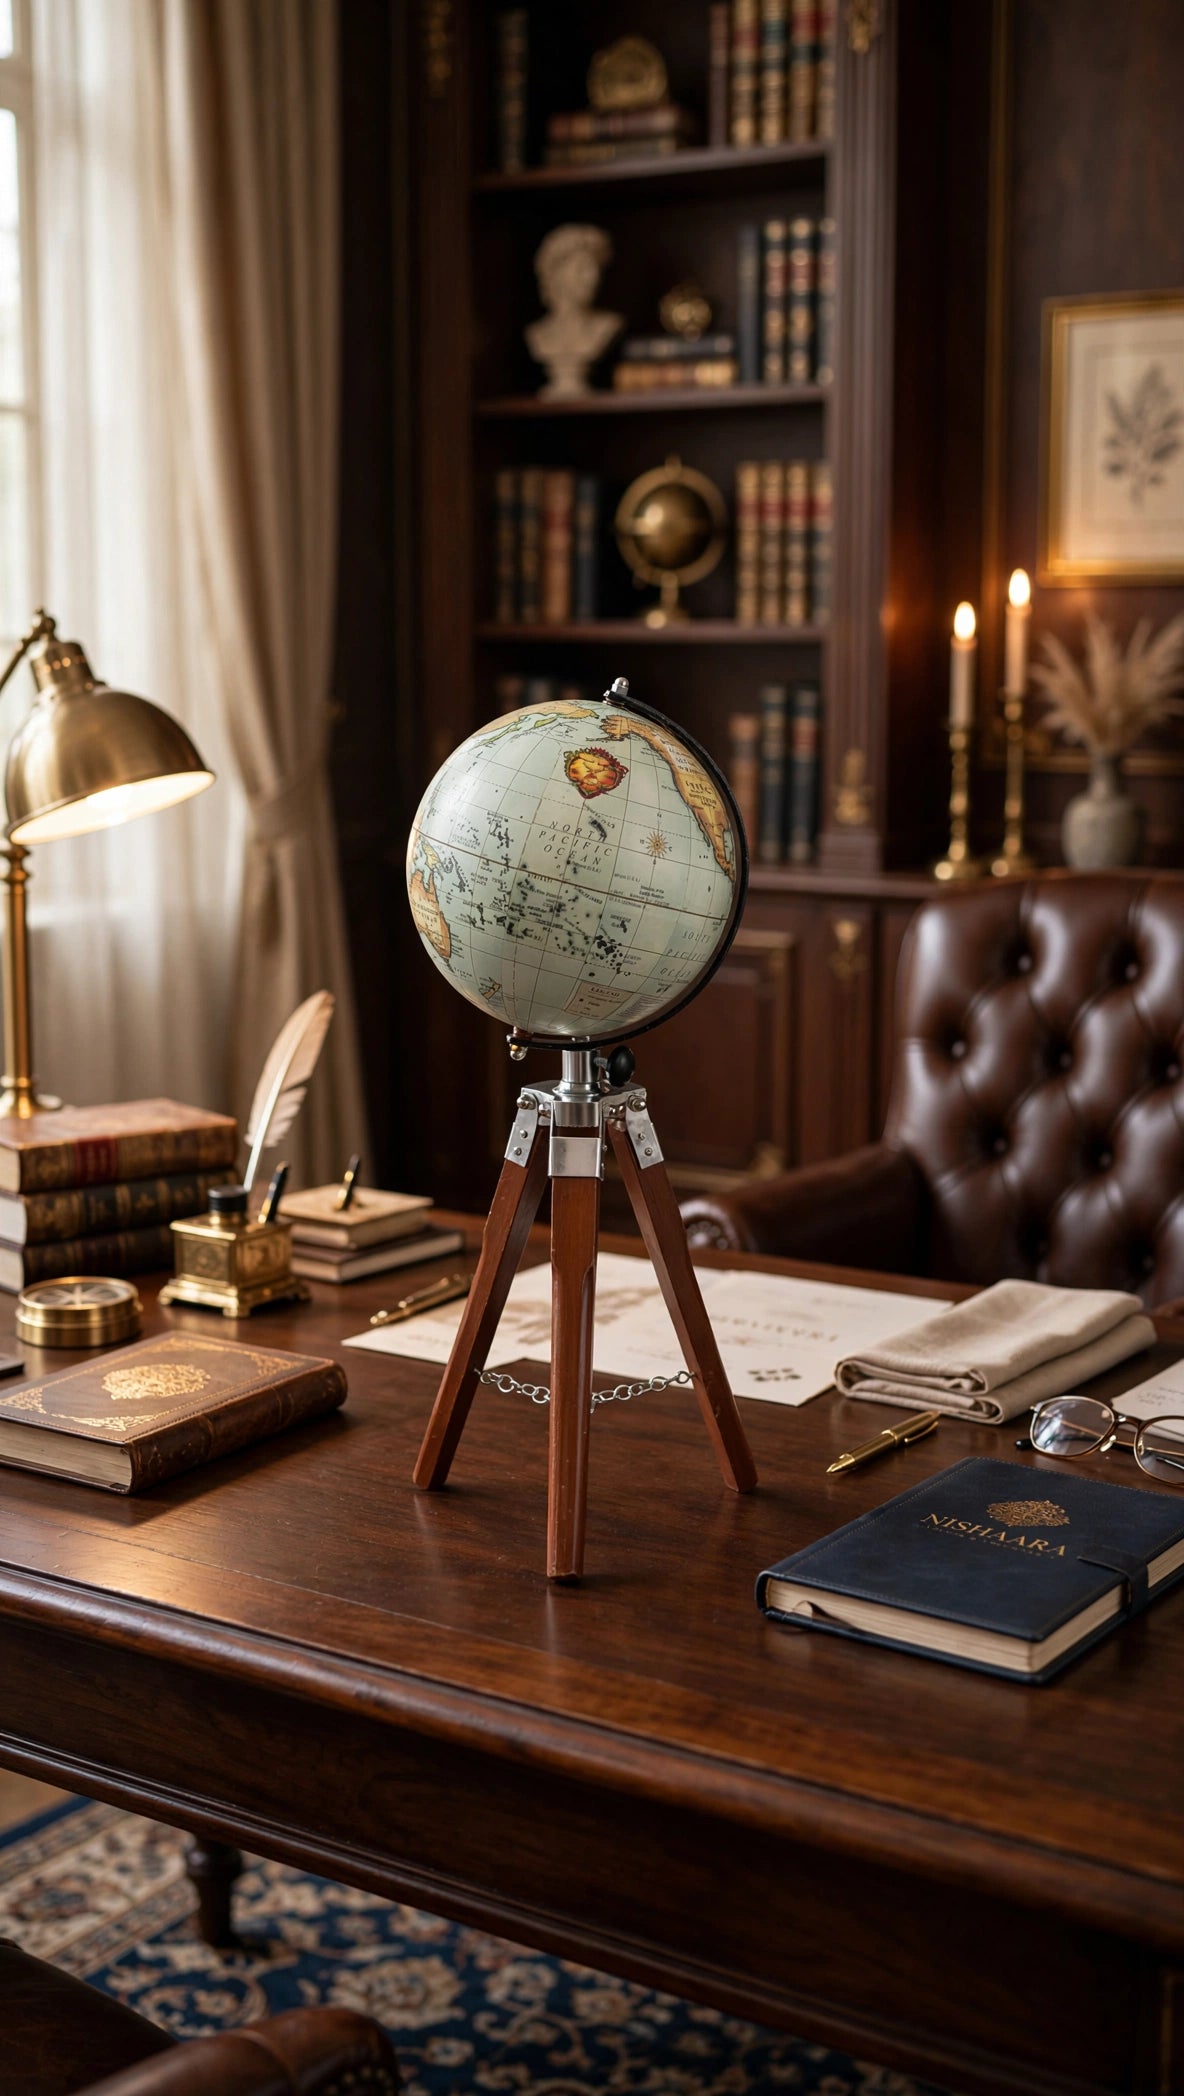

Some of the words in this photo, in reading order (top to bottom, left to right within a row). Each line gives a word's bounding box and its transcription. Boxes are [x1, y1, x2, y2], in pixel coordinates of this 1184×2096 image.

[538, 830, 612, 857] PACIFIC
[543, 844, 602, 865] OCEAN
[920, 1513, 1066, 1556] NISHAARA
